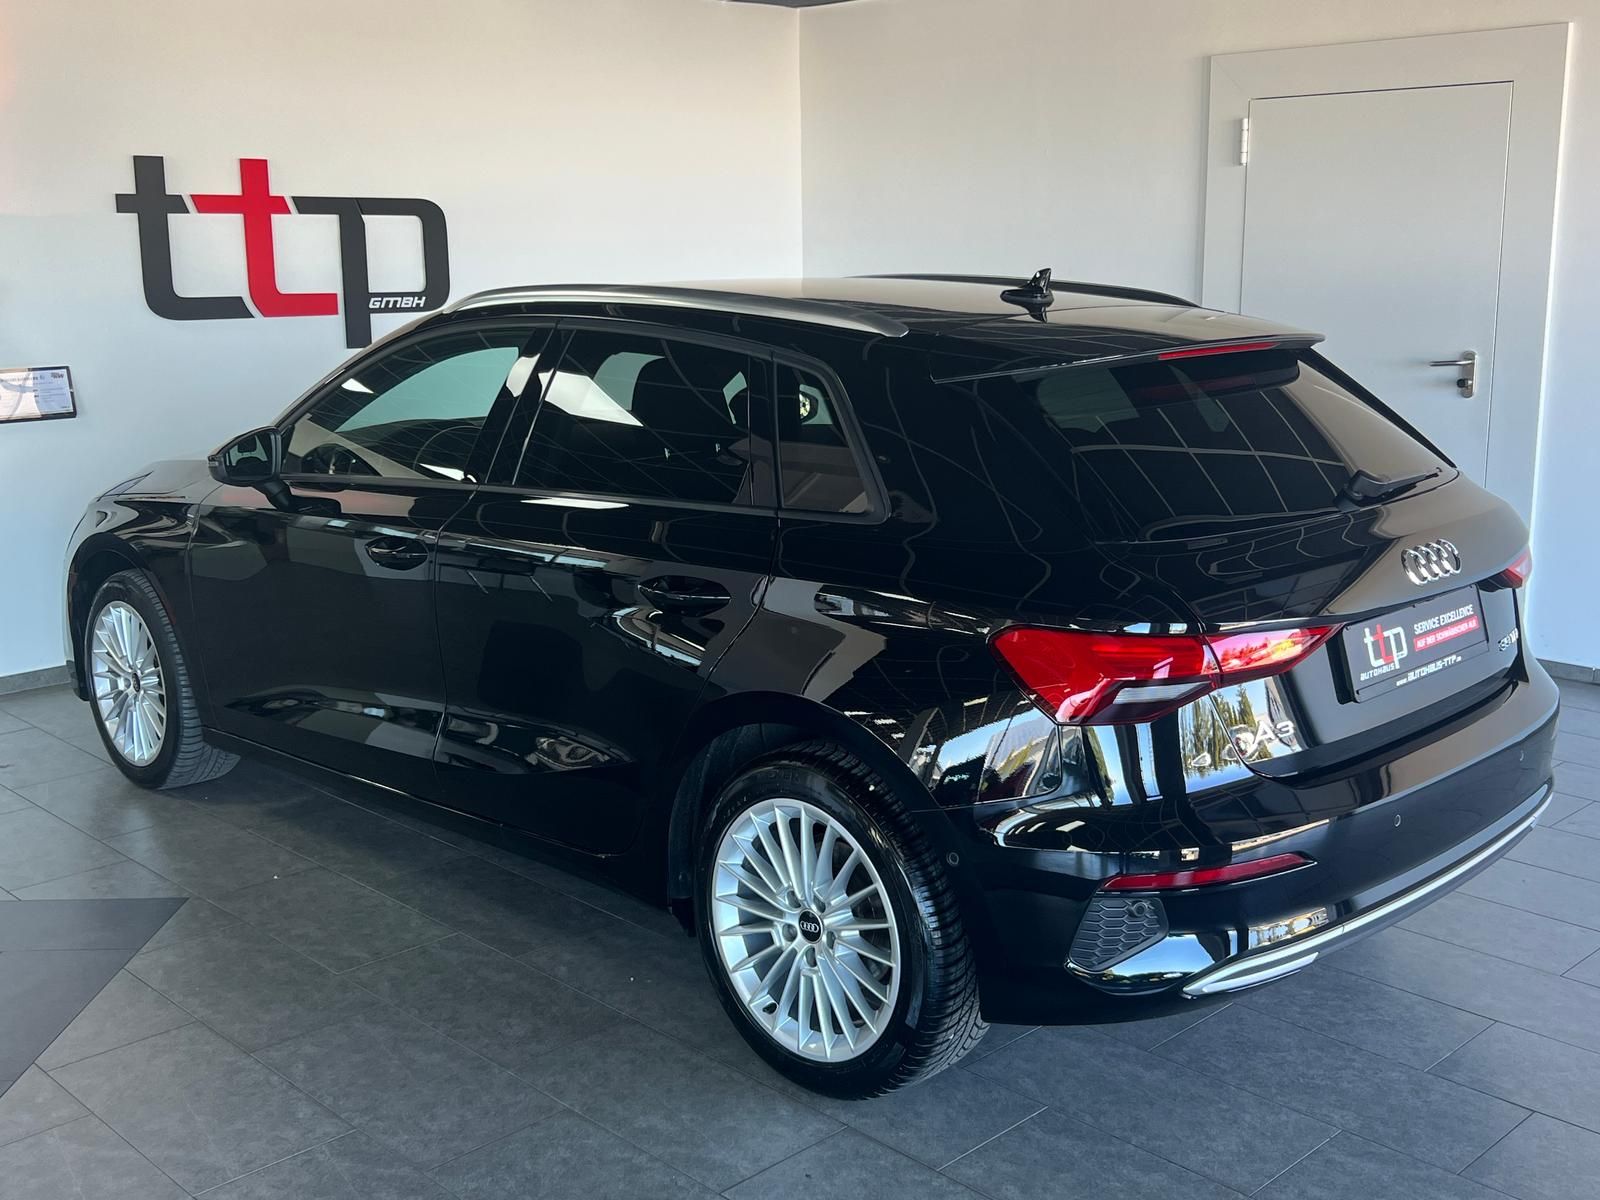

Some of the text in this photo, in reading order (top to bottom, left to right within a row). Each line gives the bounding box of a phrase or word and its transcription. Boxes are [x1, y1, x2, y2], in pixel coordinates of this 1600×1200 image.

[1413, 604, 1474, 635] SERVICE EXCELLENCE
[1254, 720, 1295, 743] A3
